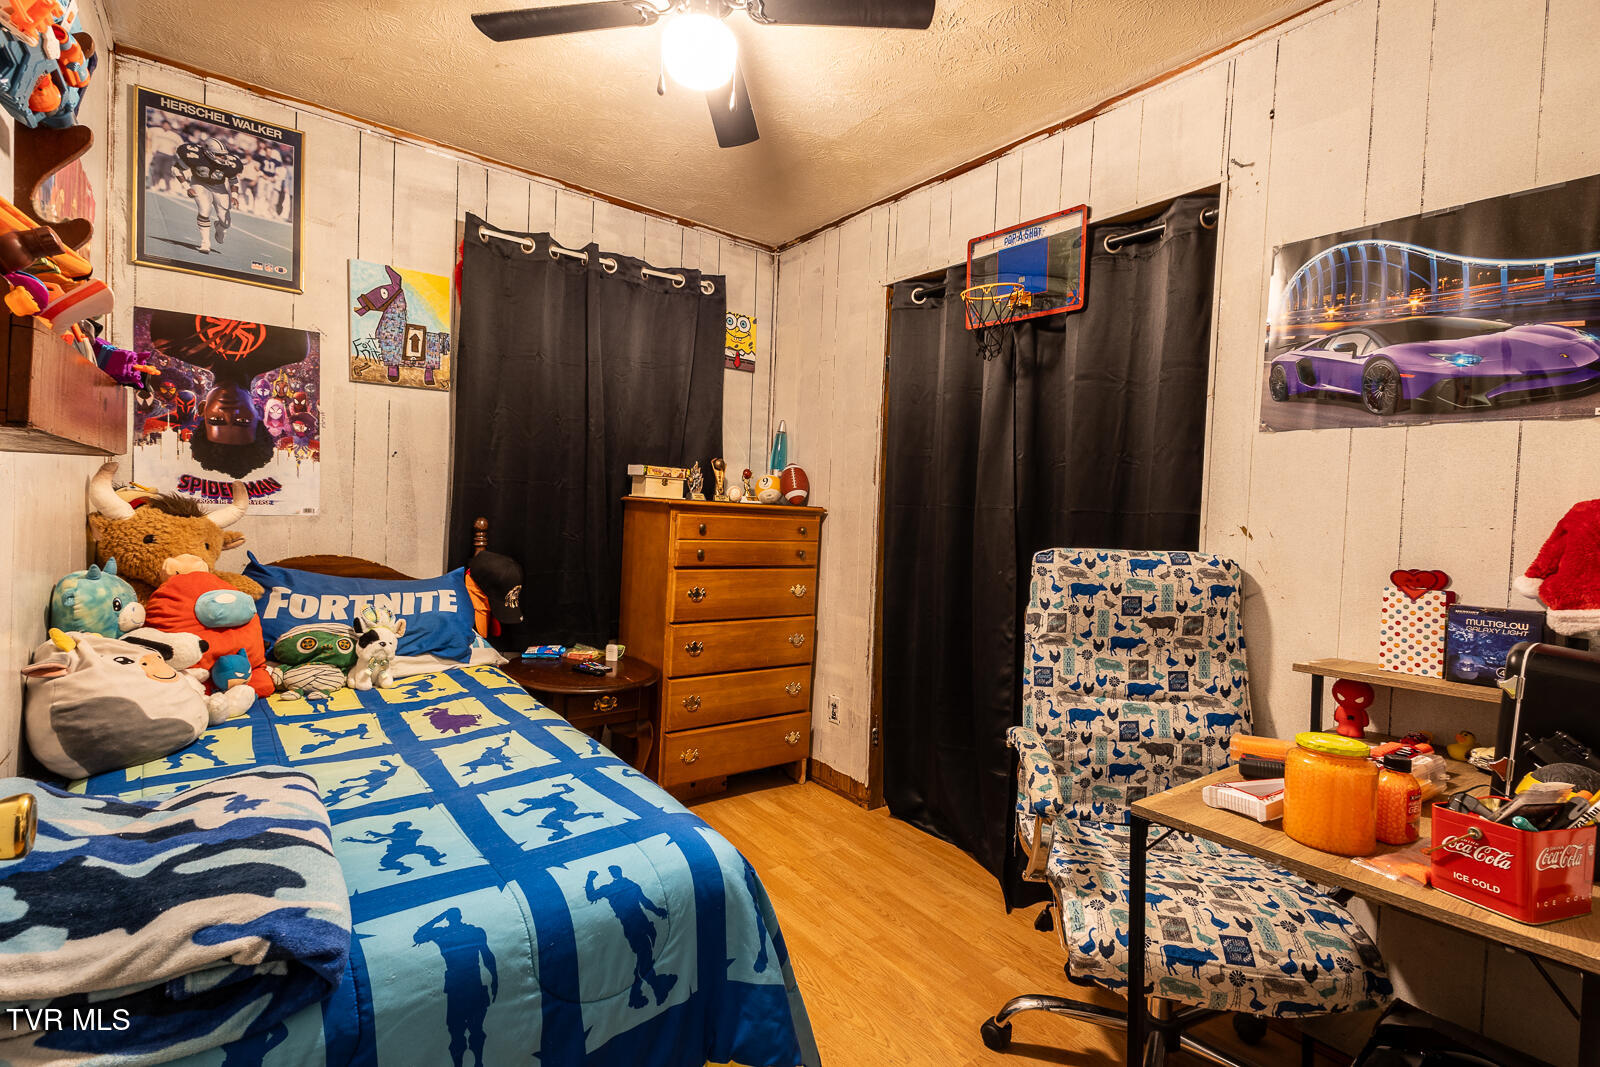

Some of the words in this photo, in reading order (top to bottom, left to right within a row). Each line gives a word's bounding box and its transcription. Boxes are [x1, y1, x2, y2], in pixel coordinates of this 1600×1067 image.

[160, 97, 229, 125] HERSCHEL
[231, 116, 282, 139] WALKER
[177, 474, 282, 499] SPIDEMAN
[263, 586, 458, 620] FORTNITE
[1465, 618, 1529, 631] MULTIGLOW
[1465, 625, 1500, 634] GALAXY
[1502, 629, 1529, 637] LIGHT
[1441, 835, 1514, 869] Coca-Cola
[1536, 844, 1583, 871] Coca-Cola
[1453, 871, 1470, 883] ICE
[1471, 878, 1501, 894] COLD
